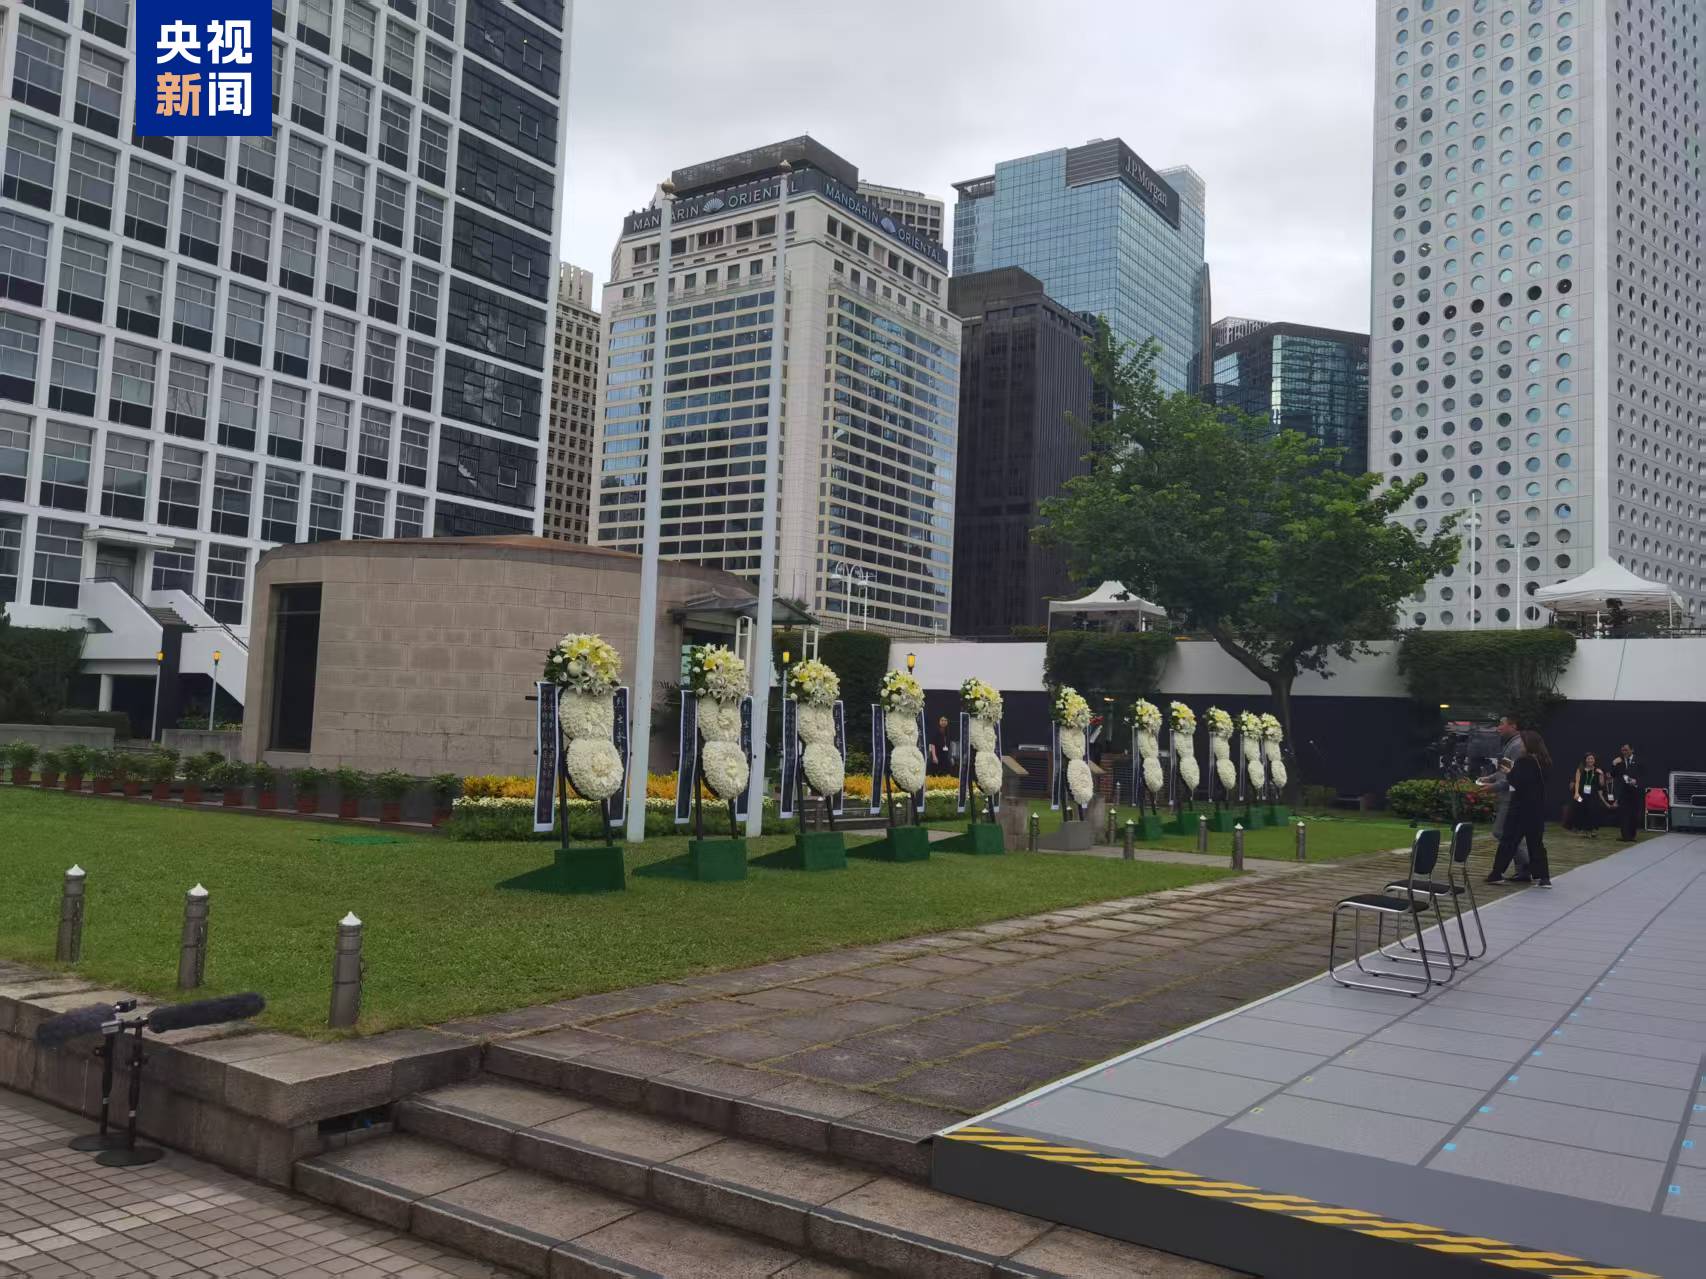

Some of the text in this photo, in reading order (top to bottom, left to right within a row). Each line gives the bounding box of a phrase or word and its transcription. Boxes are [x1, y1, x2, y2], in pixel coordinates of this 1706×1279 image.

[633, 181, 799, 232] MANARIN ORIENTL
[825, 183, 942, 262] MANDARIN ORIENTAL
